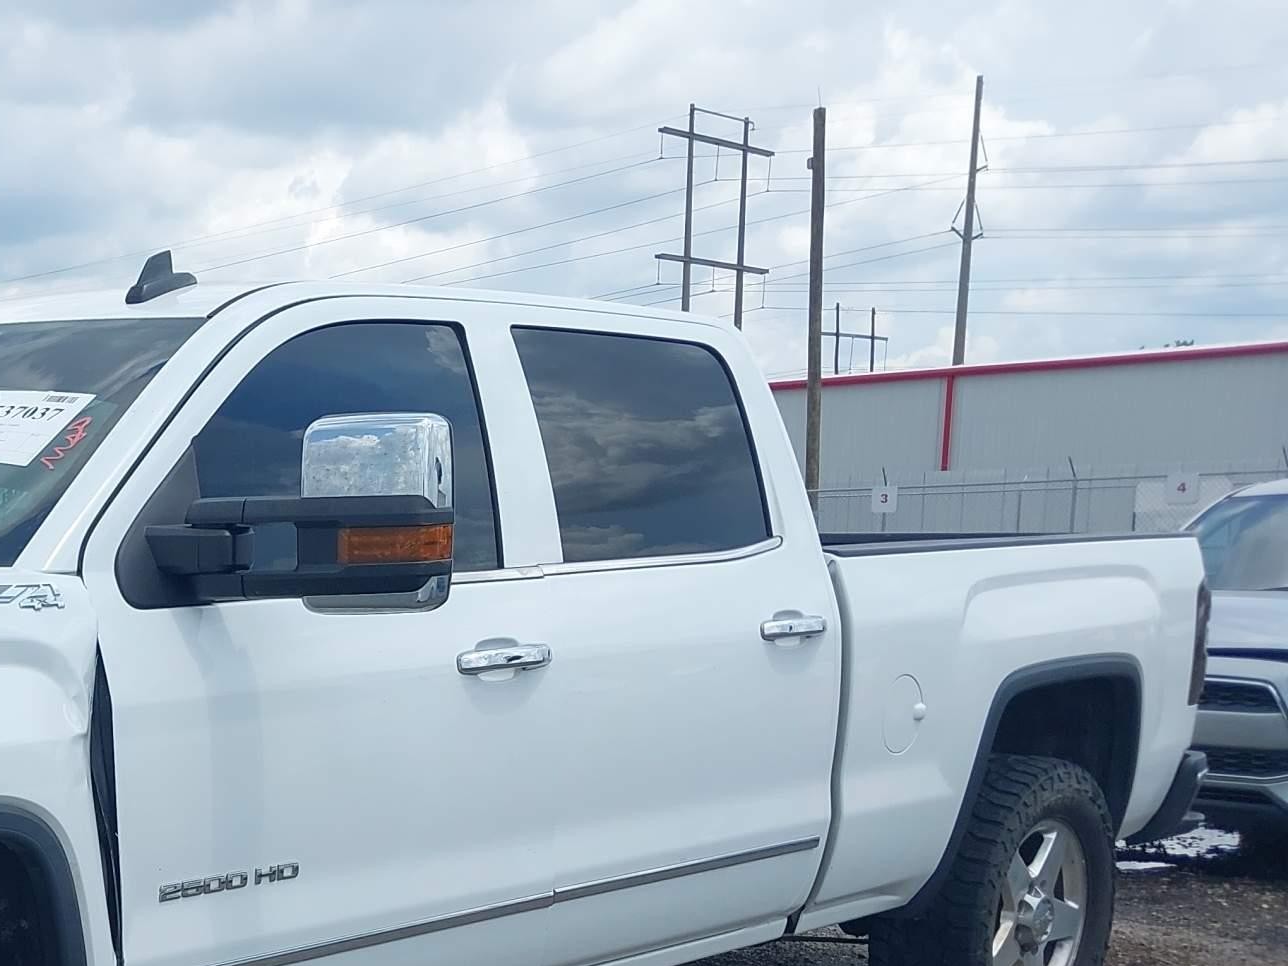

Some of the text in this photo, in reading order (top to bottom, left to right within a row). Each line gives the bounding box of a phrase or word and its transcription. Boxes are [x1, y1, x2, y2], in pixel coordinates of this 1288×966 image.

[1176, 482, 1187, 494] 4
[880, 493, 889, 504] 3
[158, 862, 300, 903] 2500 HD
